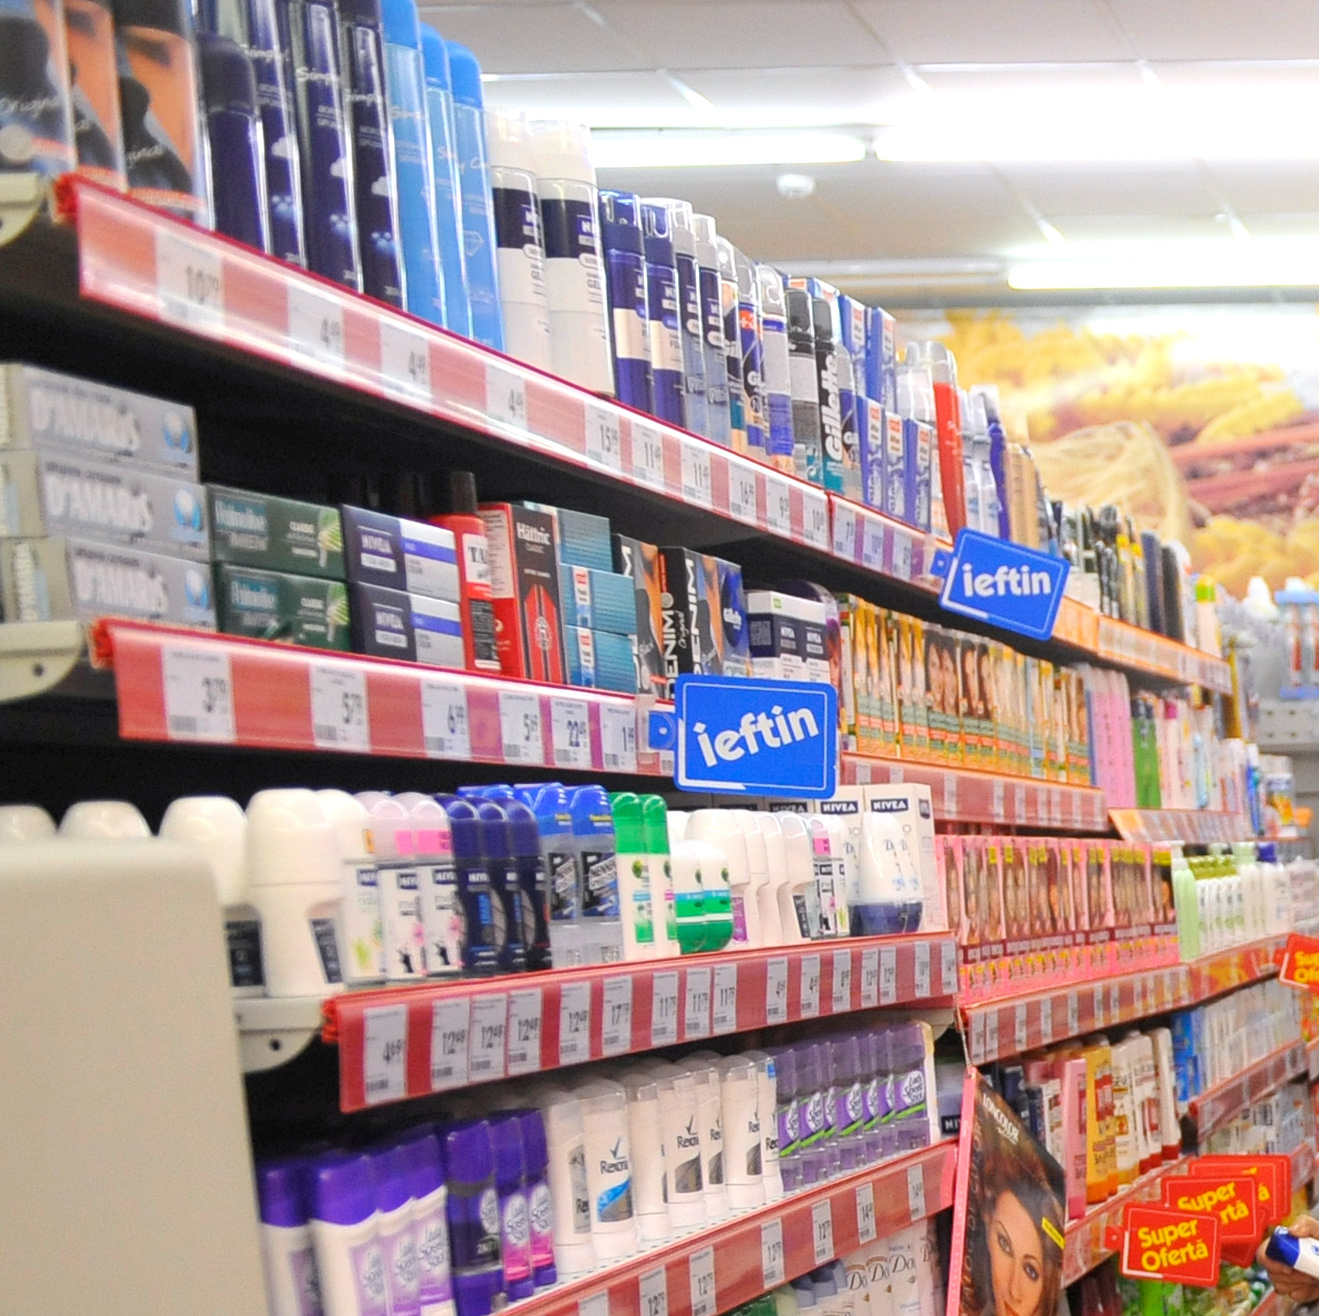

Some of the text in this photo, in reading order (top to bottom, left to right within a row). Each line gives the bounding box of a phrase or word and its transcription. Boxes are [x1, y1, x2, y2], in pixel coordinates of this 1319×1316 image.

[823, 353, 843, 462] Gillette
[961, 562, 1052, 599] ieftin
[686, 557, 700, 674] ENIM
[692, 703, 820, 768] ieftin
[821, 799, 858, 813] NIVEA
[871, 797, 908, 812] NIVEA
[982, 1092, 1020, 1140] LONCOLOR
[1178, 1181, 1237, 1212] Super
[1137, 1216, 1199, 1251] Super
[1141, 1237, 1209, 1273] Ofertă
